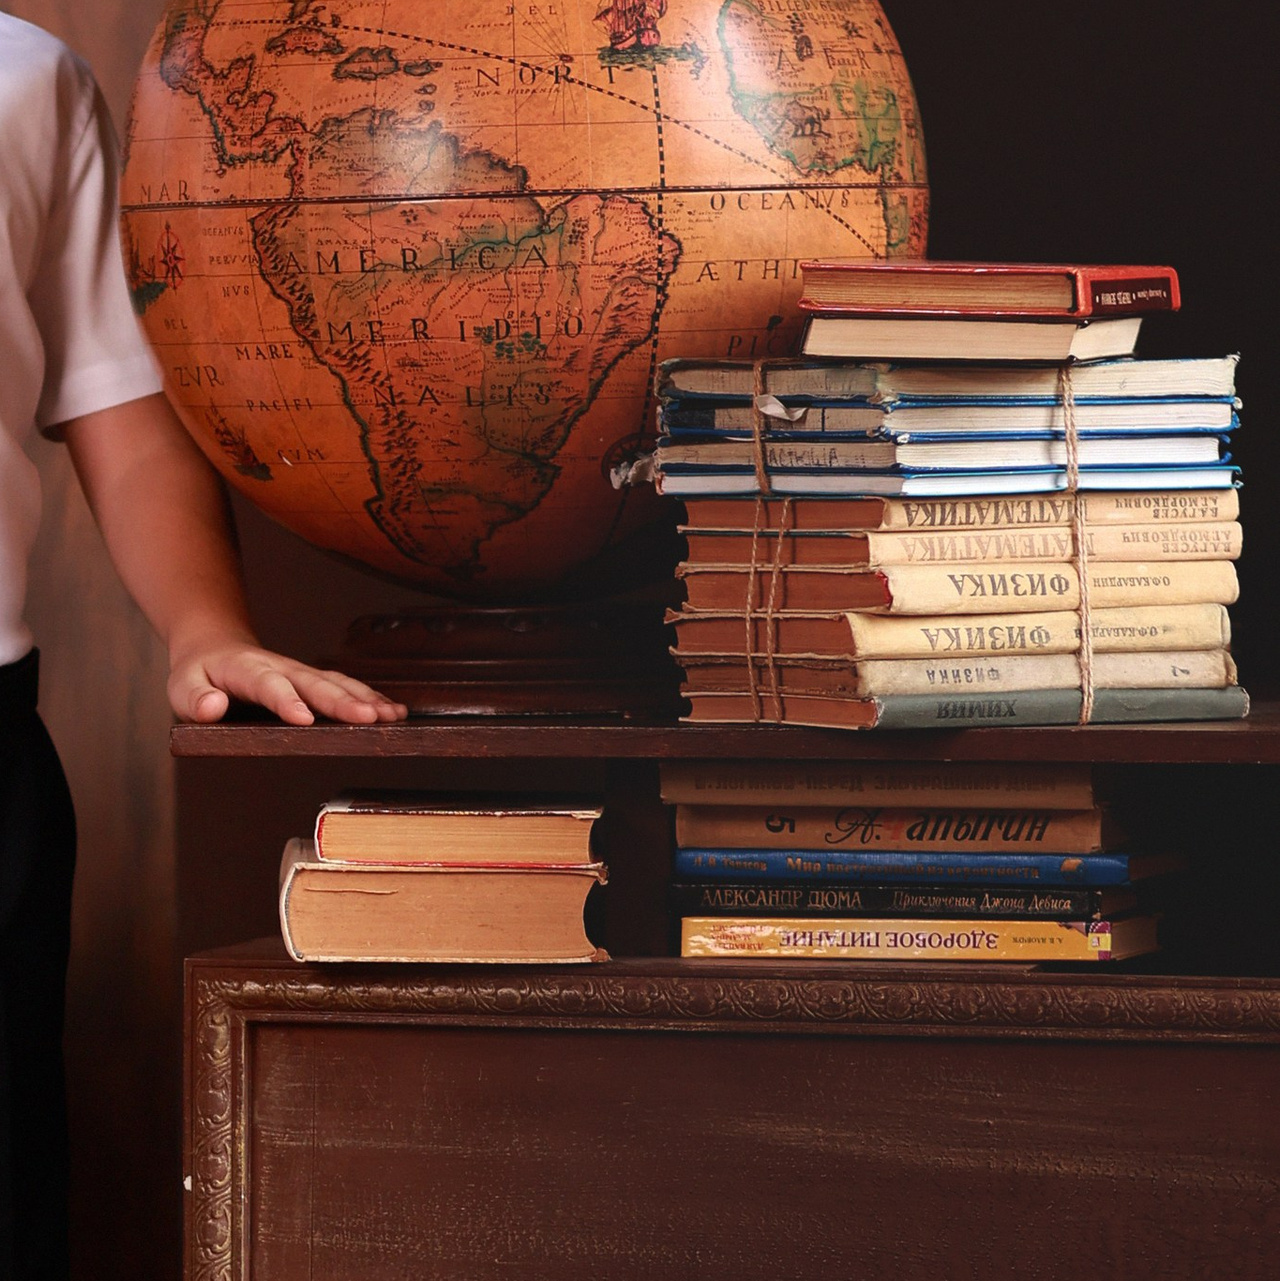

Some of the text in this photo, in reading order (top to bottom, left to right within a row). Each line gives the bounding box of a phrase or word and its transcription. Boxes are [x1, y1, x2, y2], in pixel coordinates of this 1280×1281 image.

[139, 180, 189, 202] MAR
[710, 189, 851, 211] OCEANVS
[283, 244, 549, 275] AMERICA
[696, 260, 810, 283] ÆTHI
[222, 285, 250, 297] NVS
[327, 317, 583, 345] MERIDIO
[235, 343, 293, 361] MARE
[246, 398, 313, 412] PACIFI
[373, 385, 551, 409] NALIS
[902, 498, 1088, 527] МАТЕМАТИКА
[898, 532, 1096, 562] МАТЕМАТИКА
[947, 573, 1070, 598] ФИЗИКА
[920, 625, 1052, 651] ФИЗИКА
[926, 668, 1001, 685] ФИЗИКА
[936, 699, 1018, 719] ХИМИЯ
[764, 815, 796, 833] 5
[701, 889, 803, 908] АЛЕКСАНДР
[806, 890, 863, 909] ДЮМА
[890, 891, 977, 910] Приключения
[979, 892, 1025, 910] Джона
[778, 930, 880, 948] ПИТАНИЕ
[886, 930, 1000, 950] ЗДОРОВОЕ
